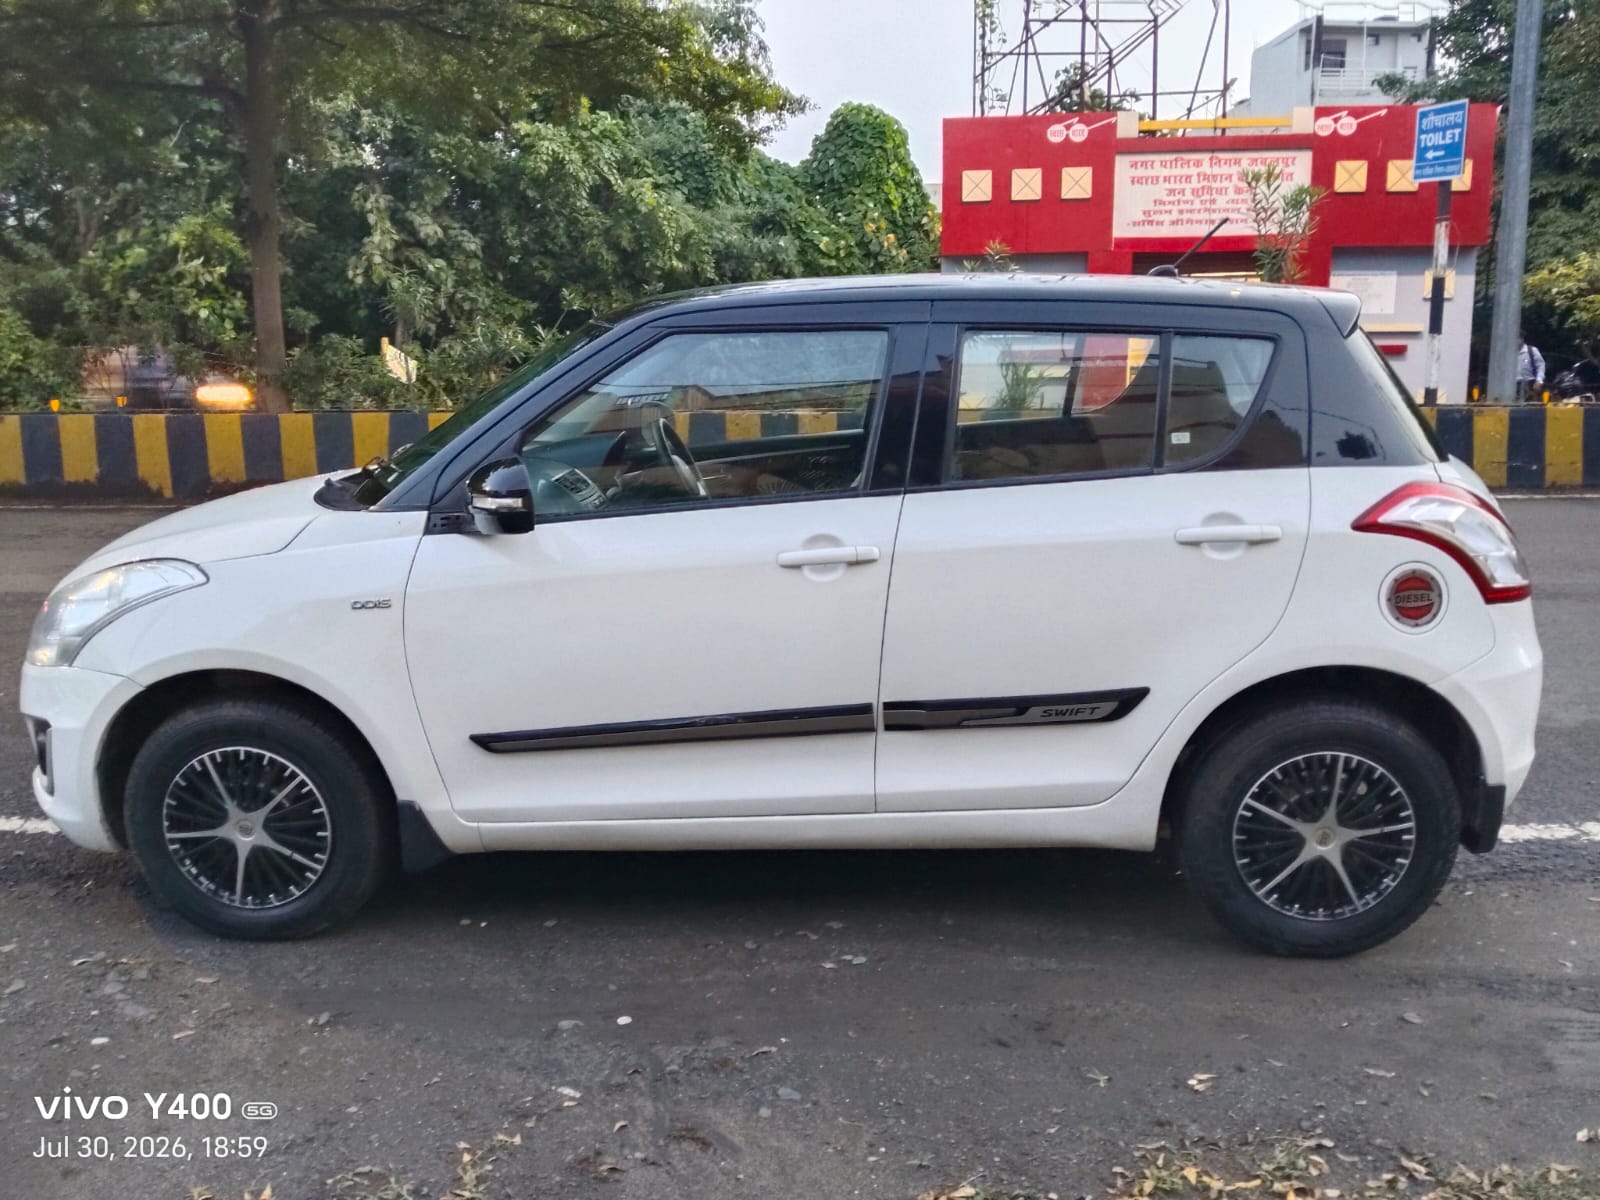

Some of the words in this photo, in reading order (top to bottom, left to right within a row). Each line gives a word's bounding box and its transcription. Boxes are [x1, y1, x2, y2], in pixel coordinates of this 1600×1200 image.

[1420, 128, 1462, 148] TOILET
[1129, 159, 1155, 169] नगर
[1209, 155, 1242, 168] निगम
[1163, 175, 1194, 185] भारत
[1197, 171, 1233, 183] मिशन
[1165, 187, 1185, 197] जन
[1191, 185, 1229, 198] सुविधा
[1395, 593, 1433, 604] DIESEL
[1041, 706, 1101, 718] SWIFT
